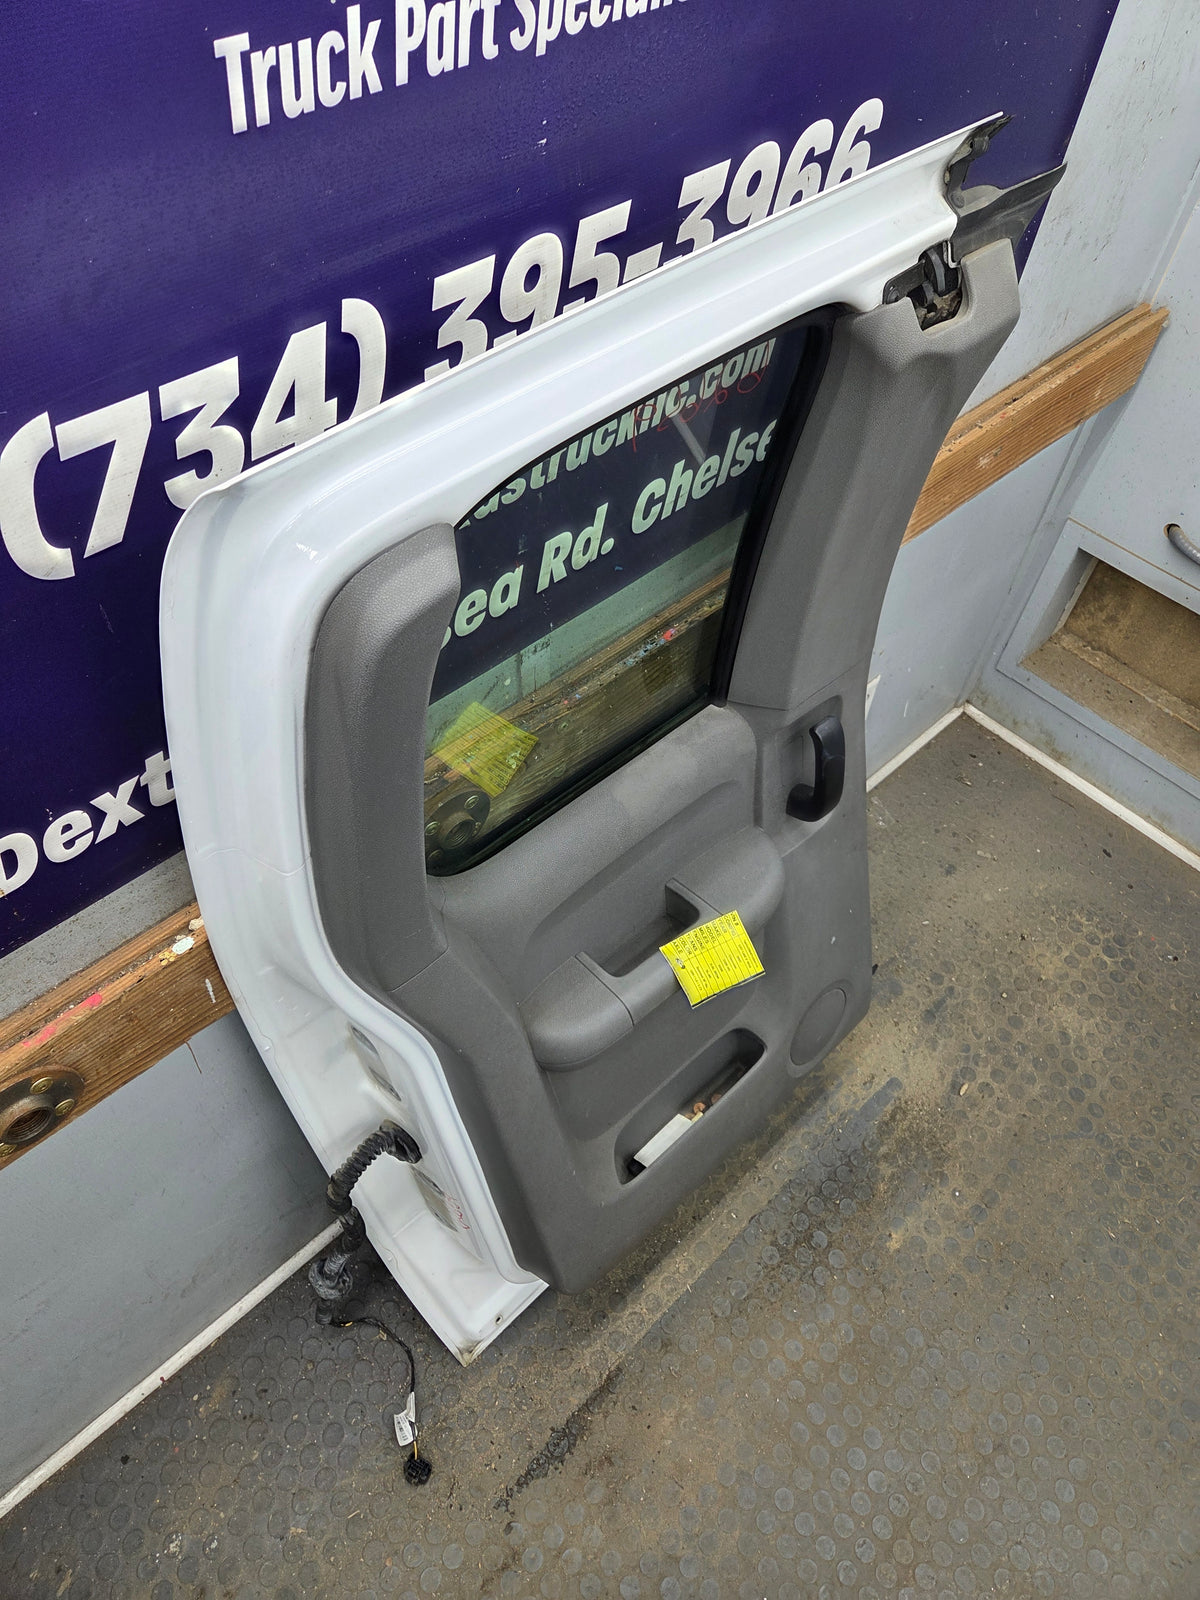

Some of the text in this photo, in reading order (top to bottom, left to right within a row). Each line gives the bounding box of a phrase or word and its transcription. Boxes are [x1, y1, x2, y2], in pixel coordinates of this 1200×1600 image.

[213, 4, 383, 135] Truck
[395, 0, 500, 87] Part
[0, 97, 884, 581] (734) 395-3966
[440, 564, 524, 650] ea
[536, 502, 615, 594] Rd.
[679, 937, 693, 955] COLOR
[705, 925, 716, 943] MODEL
